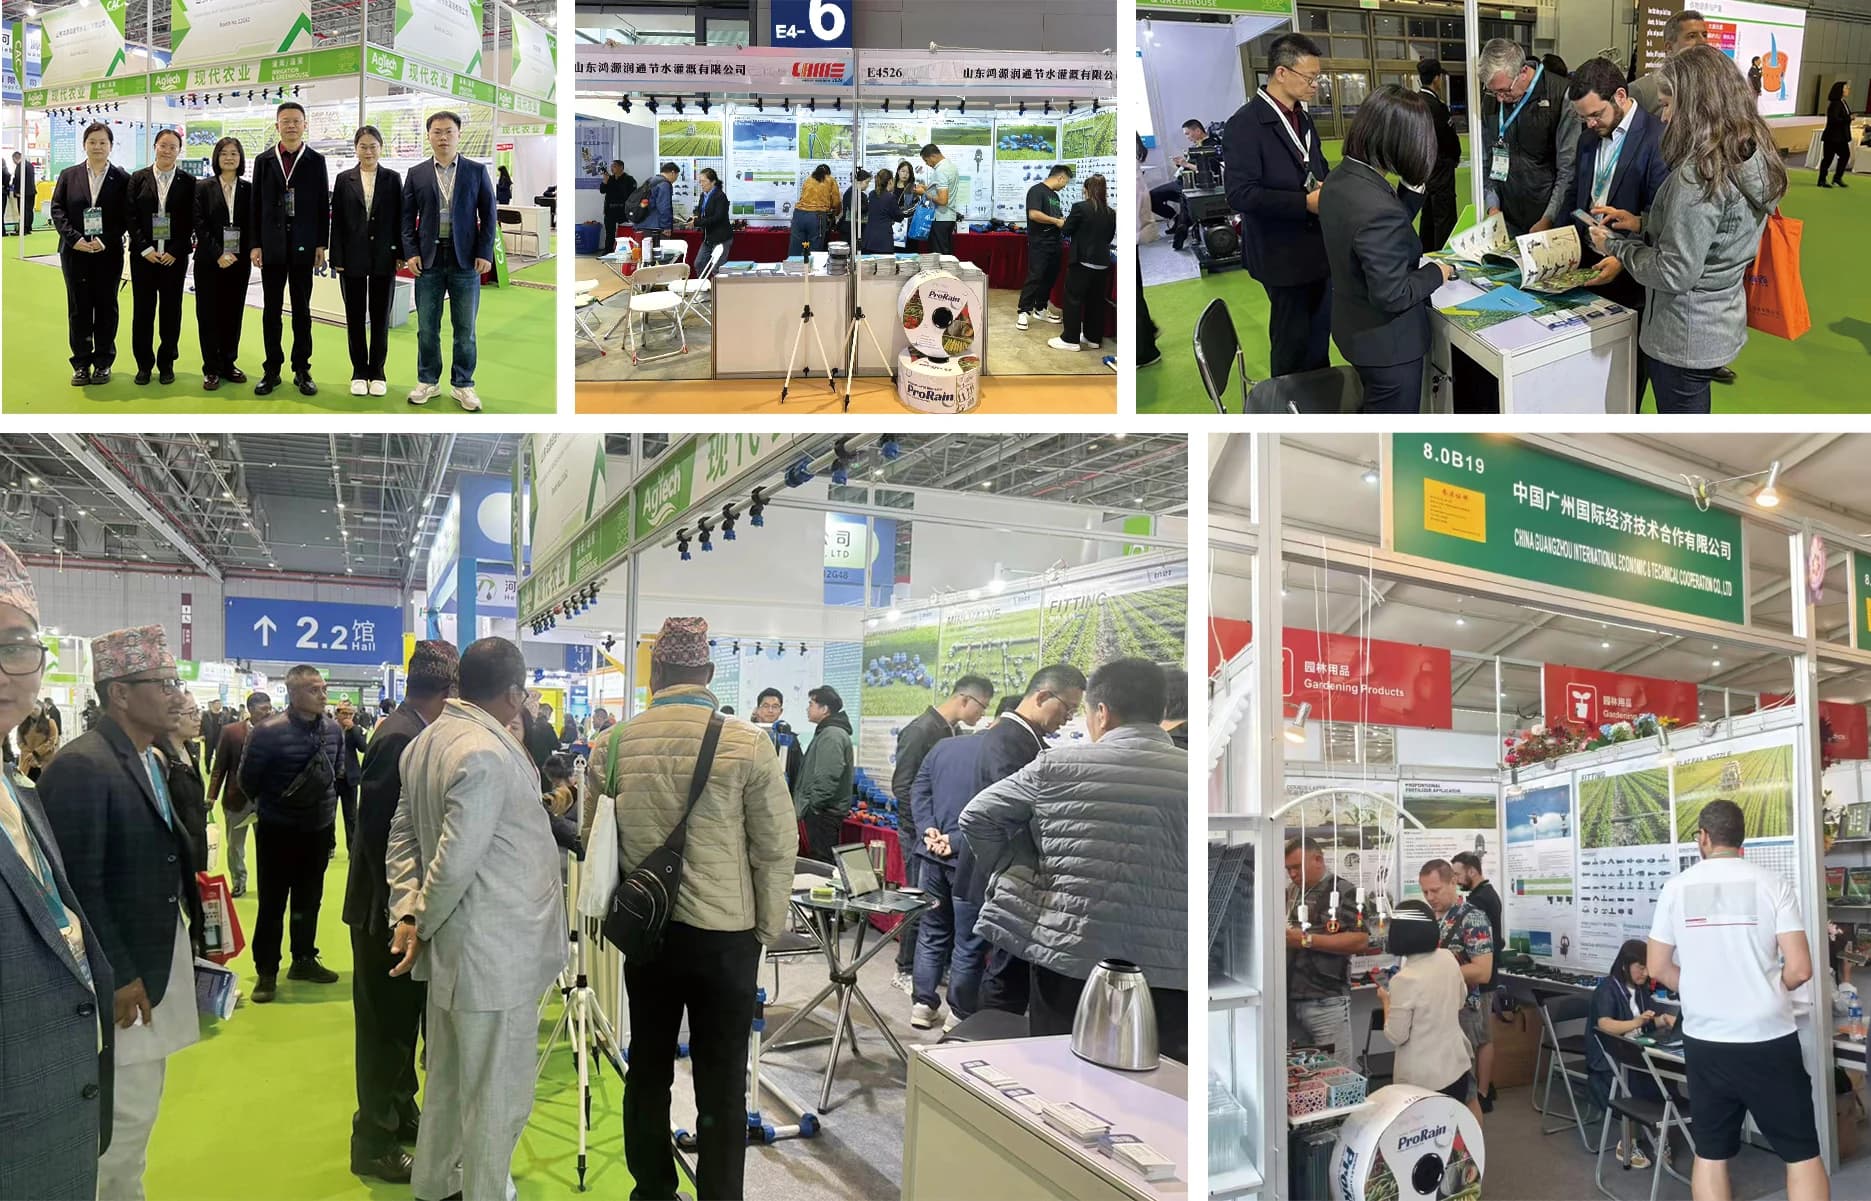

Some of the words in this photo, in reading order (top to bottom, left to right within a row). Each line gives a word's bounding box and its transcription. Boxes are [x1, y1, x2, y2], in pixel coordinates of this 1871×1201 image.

[194, 63, 251, 87] 现代农业
[409, 63, 449, 90] 现代农业
[867, 67, 903, 78] E4526
[963, 67, 1117, 81] 山东鸿源润通节水灌溉有限公
[502, 125, 540, 135] 现代农业
[929, 291, 960, 303] ProRain
[907, 384, 954, 402] ProRain
[1423, 442, 1485, 474] 8.0B19
[1513, 480, 1731, 560] 中国广州国际经济技术合作有限公司
[1514, 528, 1534, 549] CHINA
[1535, 533, 1573, 559] GUANGZHOU
[1573, 543, 1618, 570] INTERNATIONAL
[1619, 554, 1647, 577] ECONOMIC
[1651, 562, 1679, 585] TECHNICAL
[1679, 568, 1713, 593] COOPERATION
[1049, 592, 1107, 614] FITTING
[296, 616, 348, 650] 2.2
[352, 620, 375, 642] 馆
[352, 642, 375, 652] Hall
[1304, 660, 1350, 677] 园林用品
[1304, 679, 1358, 695] Gardening
[1360, 684, 1404, 697] Products
[1603, 695, 1633, 708] 园林用品
[1398, 1125, 1447, 1148] ProRain
